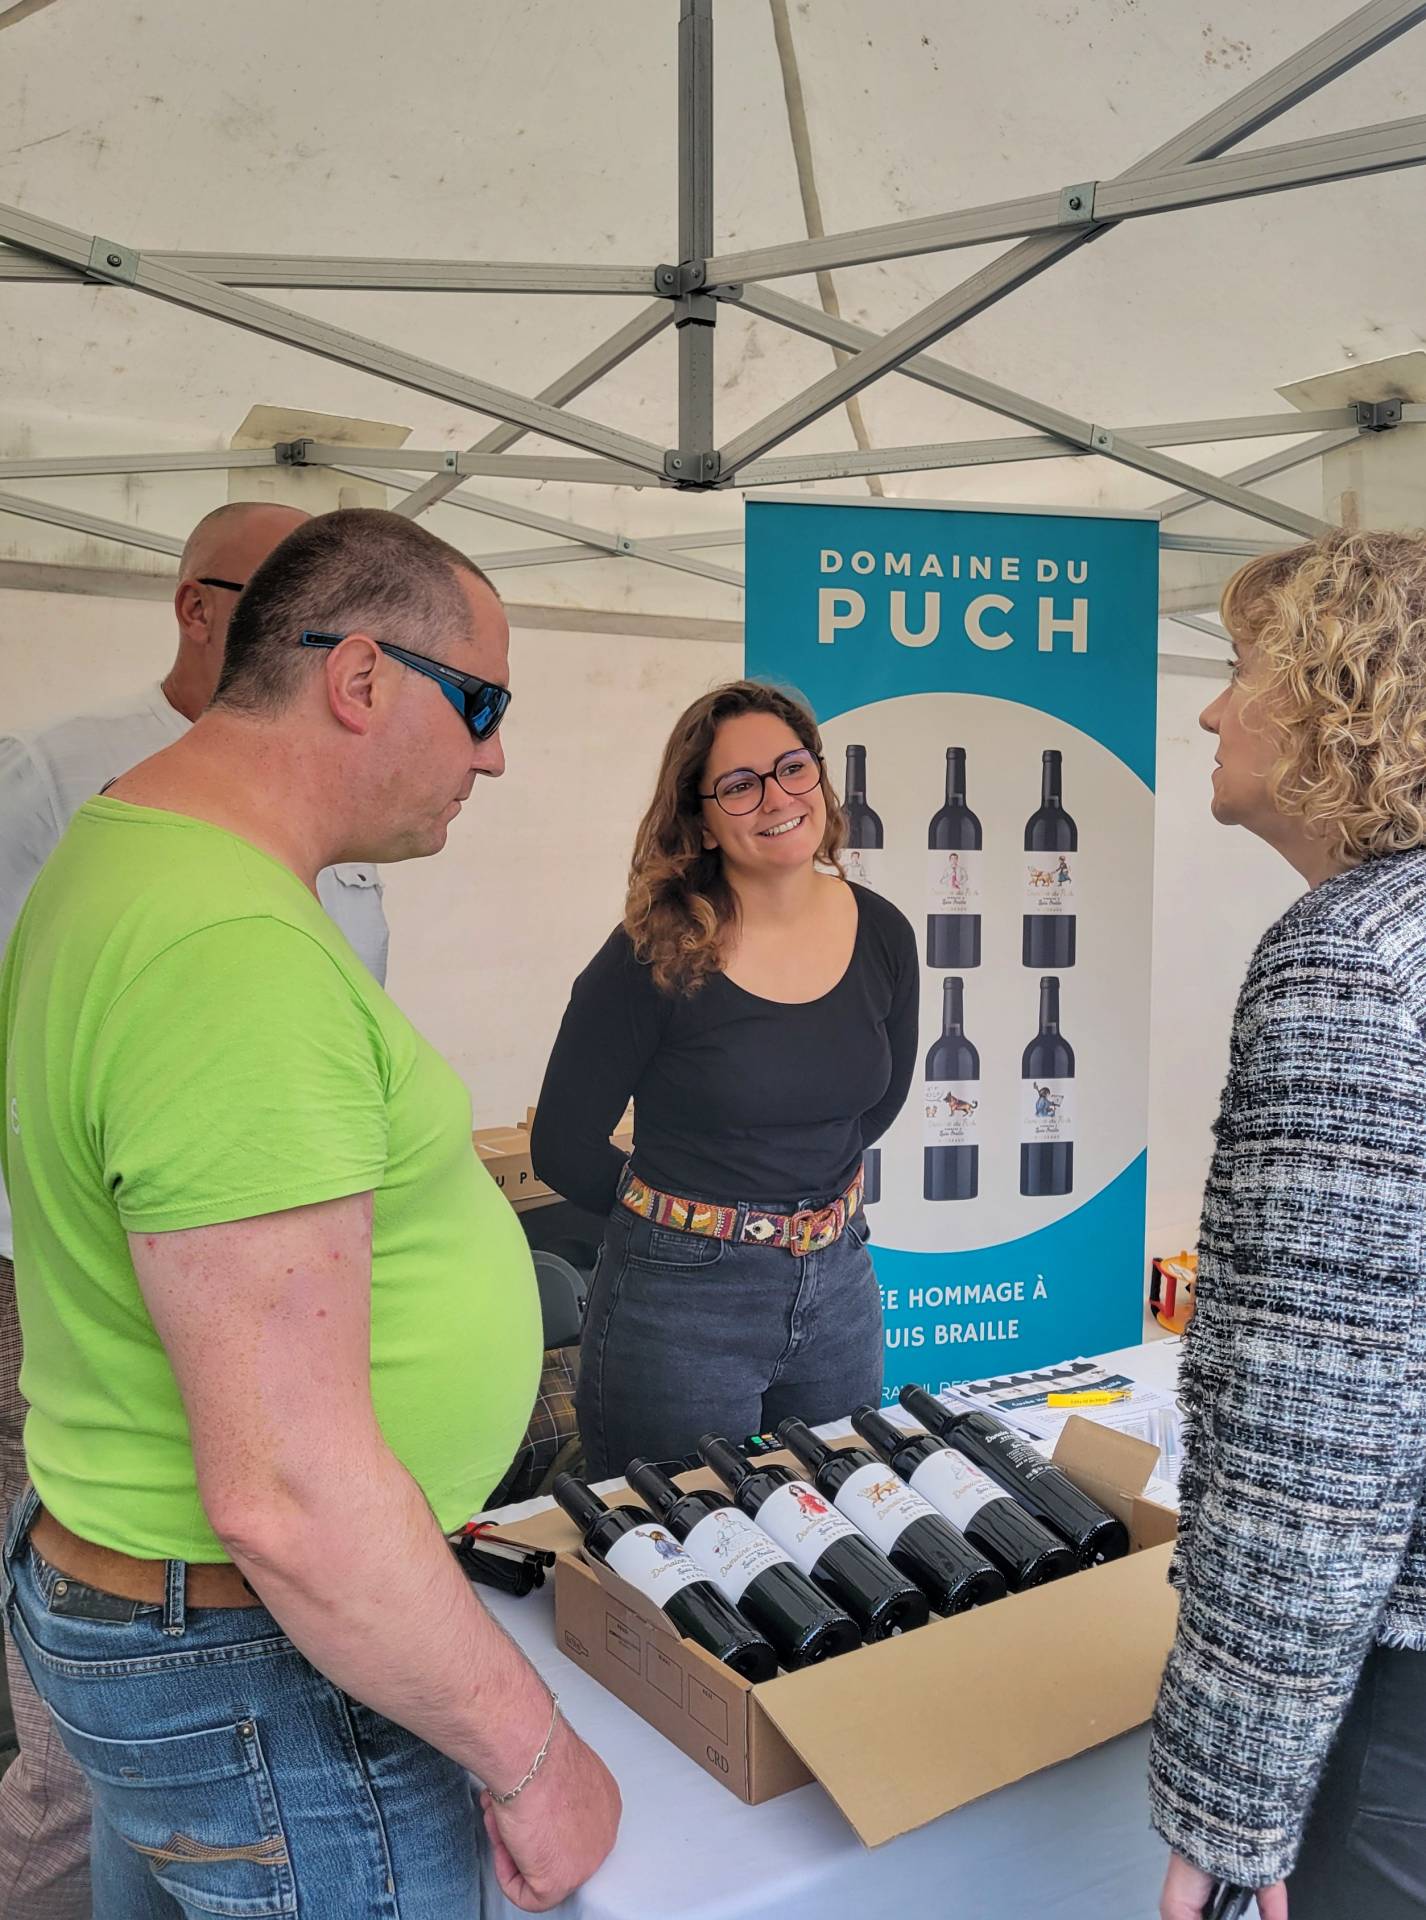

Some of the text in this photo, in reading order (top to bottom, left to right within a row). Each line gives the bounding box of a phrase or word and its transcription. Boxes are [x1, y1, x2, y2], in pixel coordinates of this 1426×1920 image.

[819, 549, 1089, 584] DOMAINE DU
[818, 587, 1089, 654] PUCH
[879, 1273, 1049, 1311] ÉE HOMMAGE À
[885, 1319, 1020, 1349] UIS BRAILLE
[706, 1744, 729, 1774] CRD
